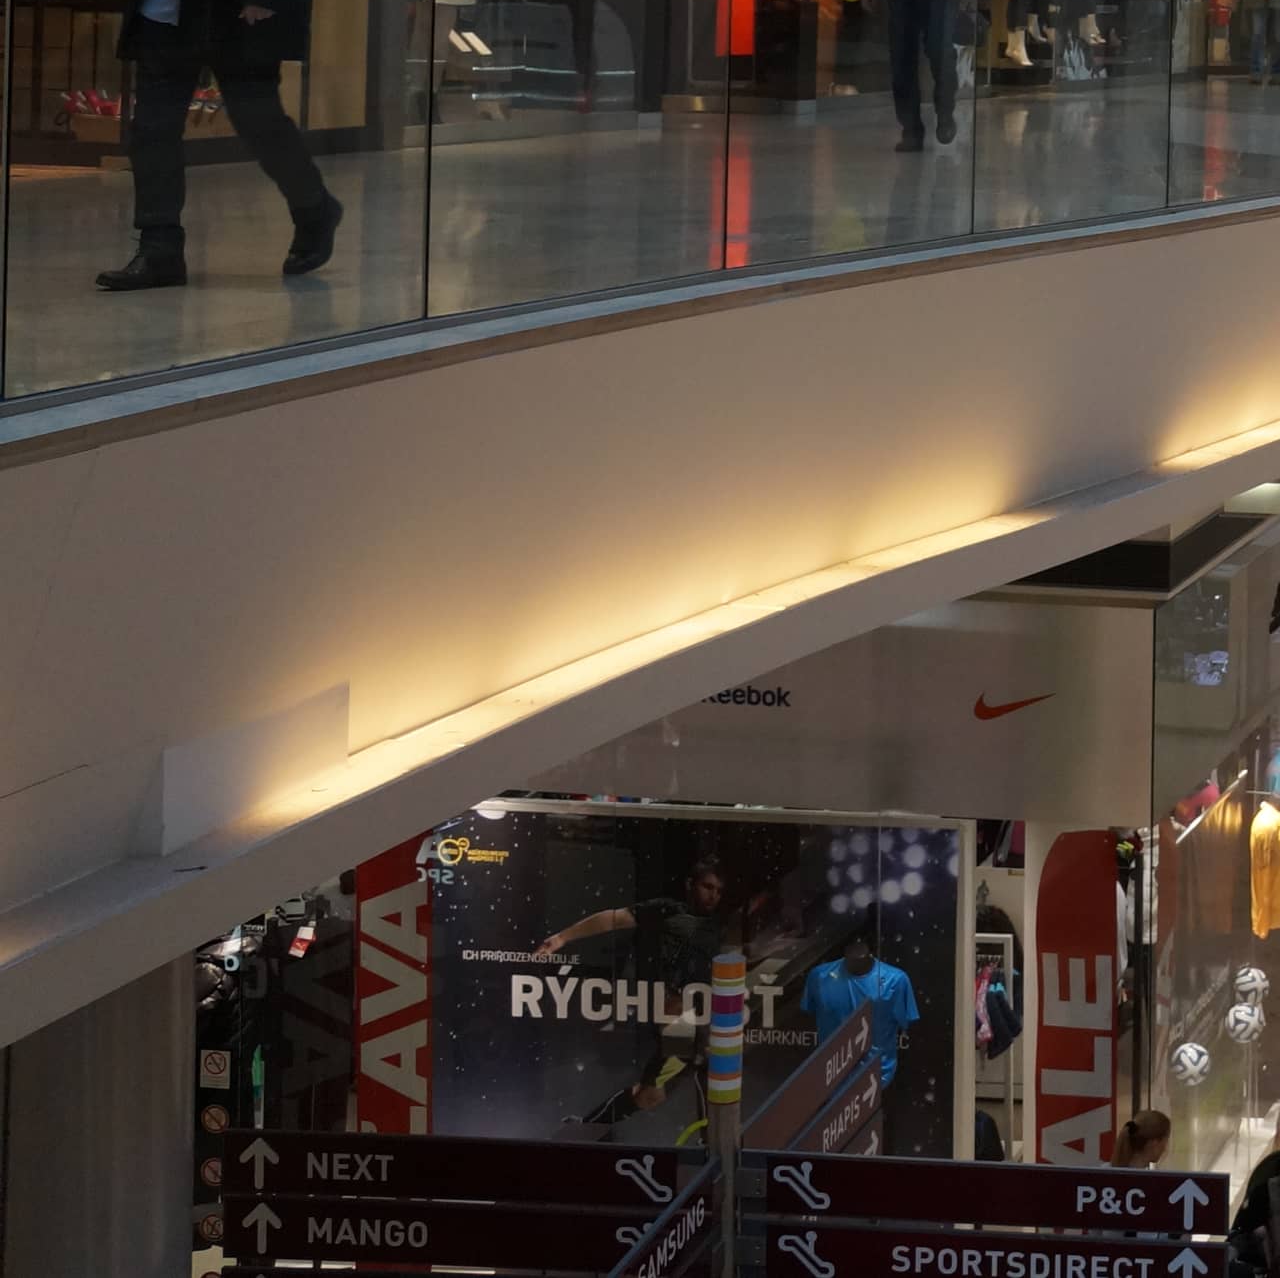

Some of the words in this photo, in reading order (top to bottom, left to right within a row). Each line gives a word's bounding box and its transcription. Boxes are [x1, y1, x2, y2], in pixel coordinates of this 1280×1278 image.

[701, 685, 792, 708] eebok
[511, 965, 784, 1028] RÝCHLOŤ
[825, 1038, 853, 1086] BILLA
[1041, 952, 1113, 1165] ALE
[822, 1095, 861, 1154] RHAPIS
[306, 1152, 394, 1182] NEXT
[1076, 1185, 1147, 1215] P&C
[307, 1217, 428, 1249] MANGO
[638, 1197, 706, 1278] SAMSUNG
[891, 1245, 1154, 1278] SPORTSDIRECT
